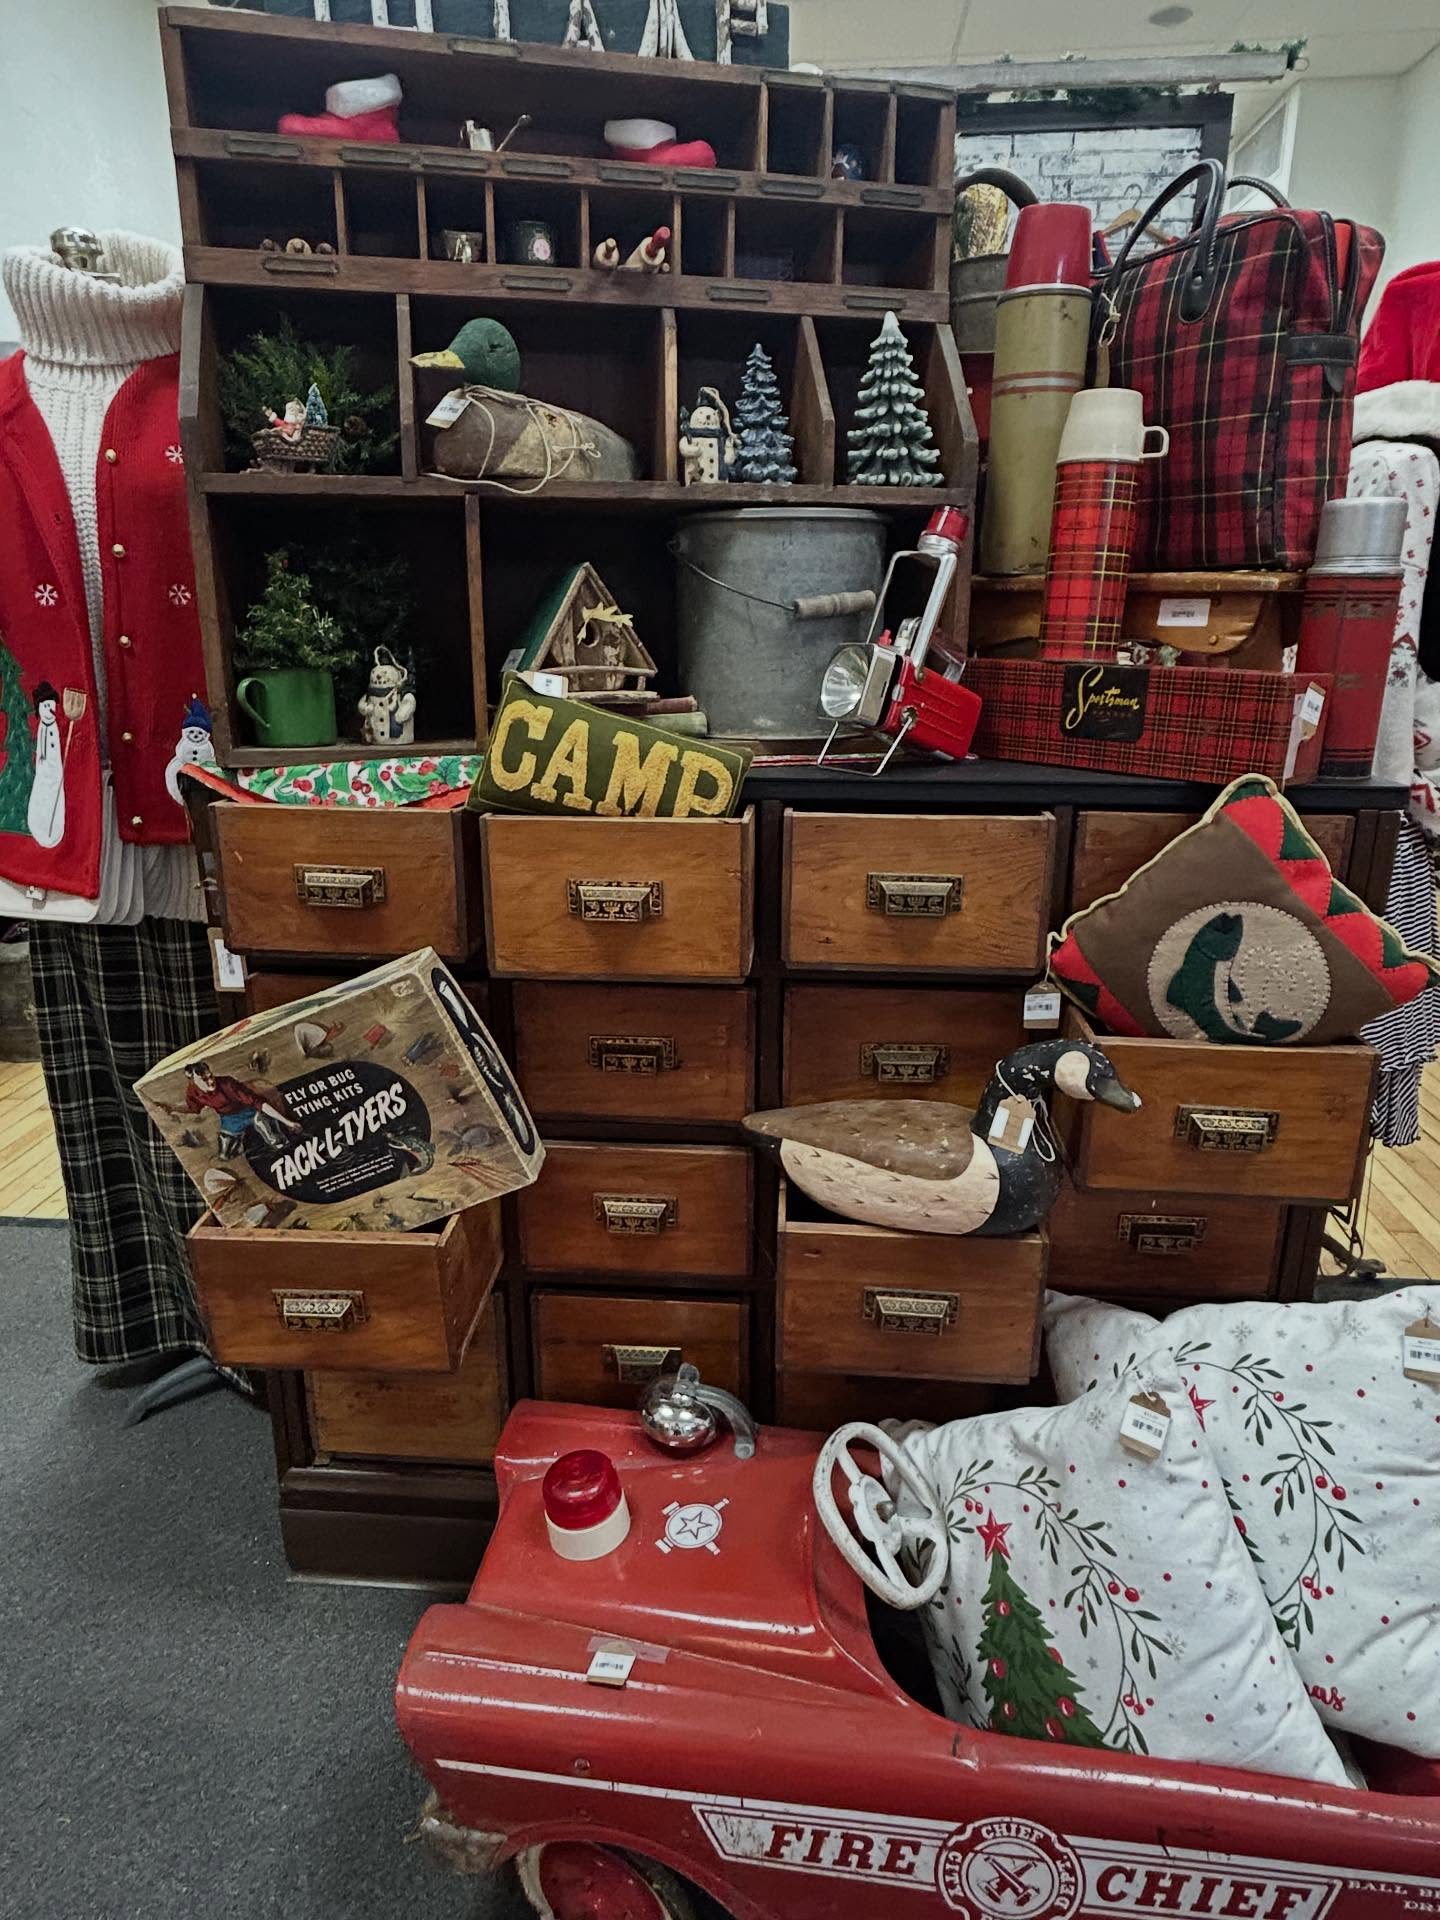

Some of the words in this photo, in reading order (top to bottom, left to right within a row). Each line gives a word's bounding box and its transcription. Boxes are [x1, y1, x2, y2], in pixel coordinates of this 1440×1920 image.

[1066, 664, 1140, 730] Sportsman
[490, 699, 734, 818] CAMP
[285, 1087, 308, 1105] FLY
[308, 1080, 328, 1095] OR
[328, 1069, 356, 1087] BUG
[293, 1095, 332, 1118] TYING
[333, 1082, 364, 1102] KITS
[270, 1082, 407, 1190] TACK-L-TYERS
[981, 1822, 1045, 1844] CHIEF
[764, 1824, 922, 1875] FIRE
[1096, 1865, 1313, 1920] CHIEF
[945, 1851, 965, 1897] CITY
[1348, 1880, 1408, 1895] BALL
